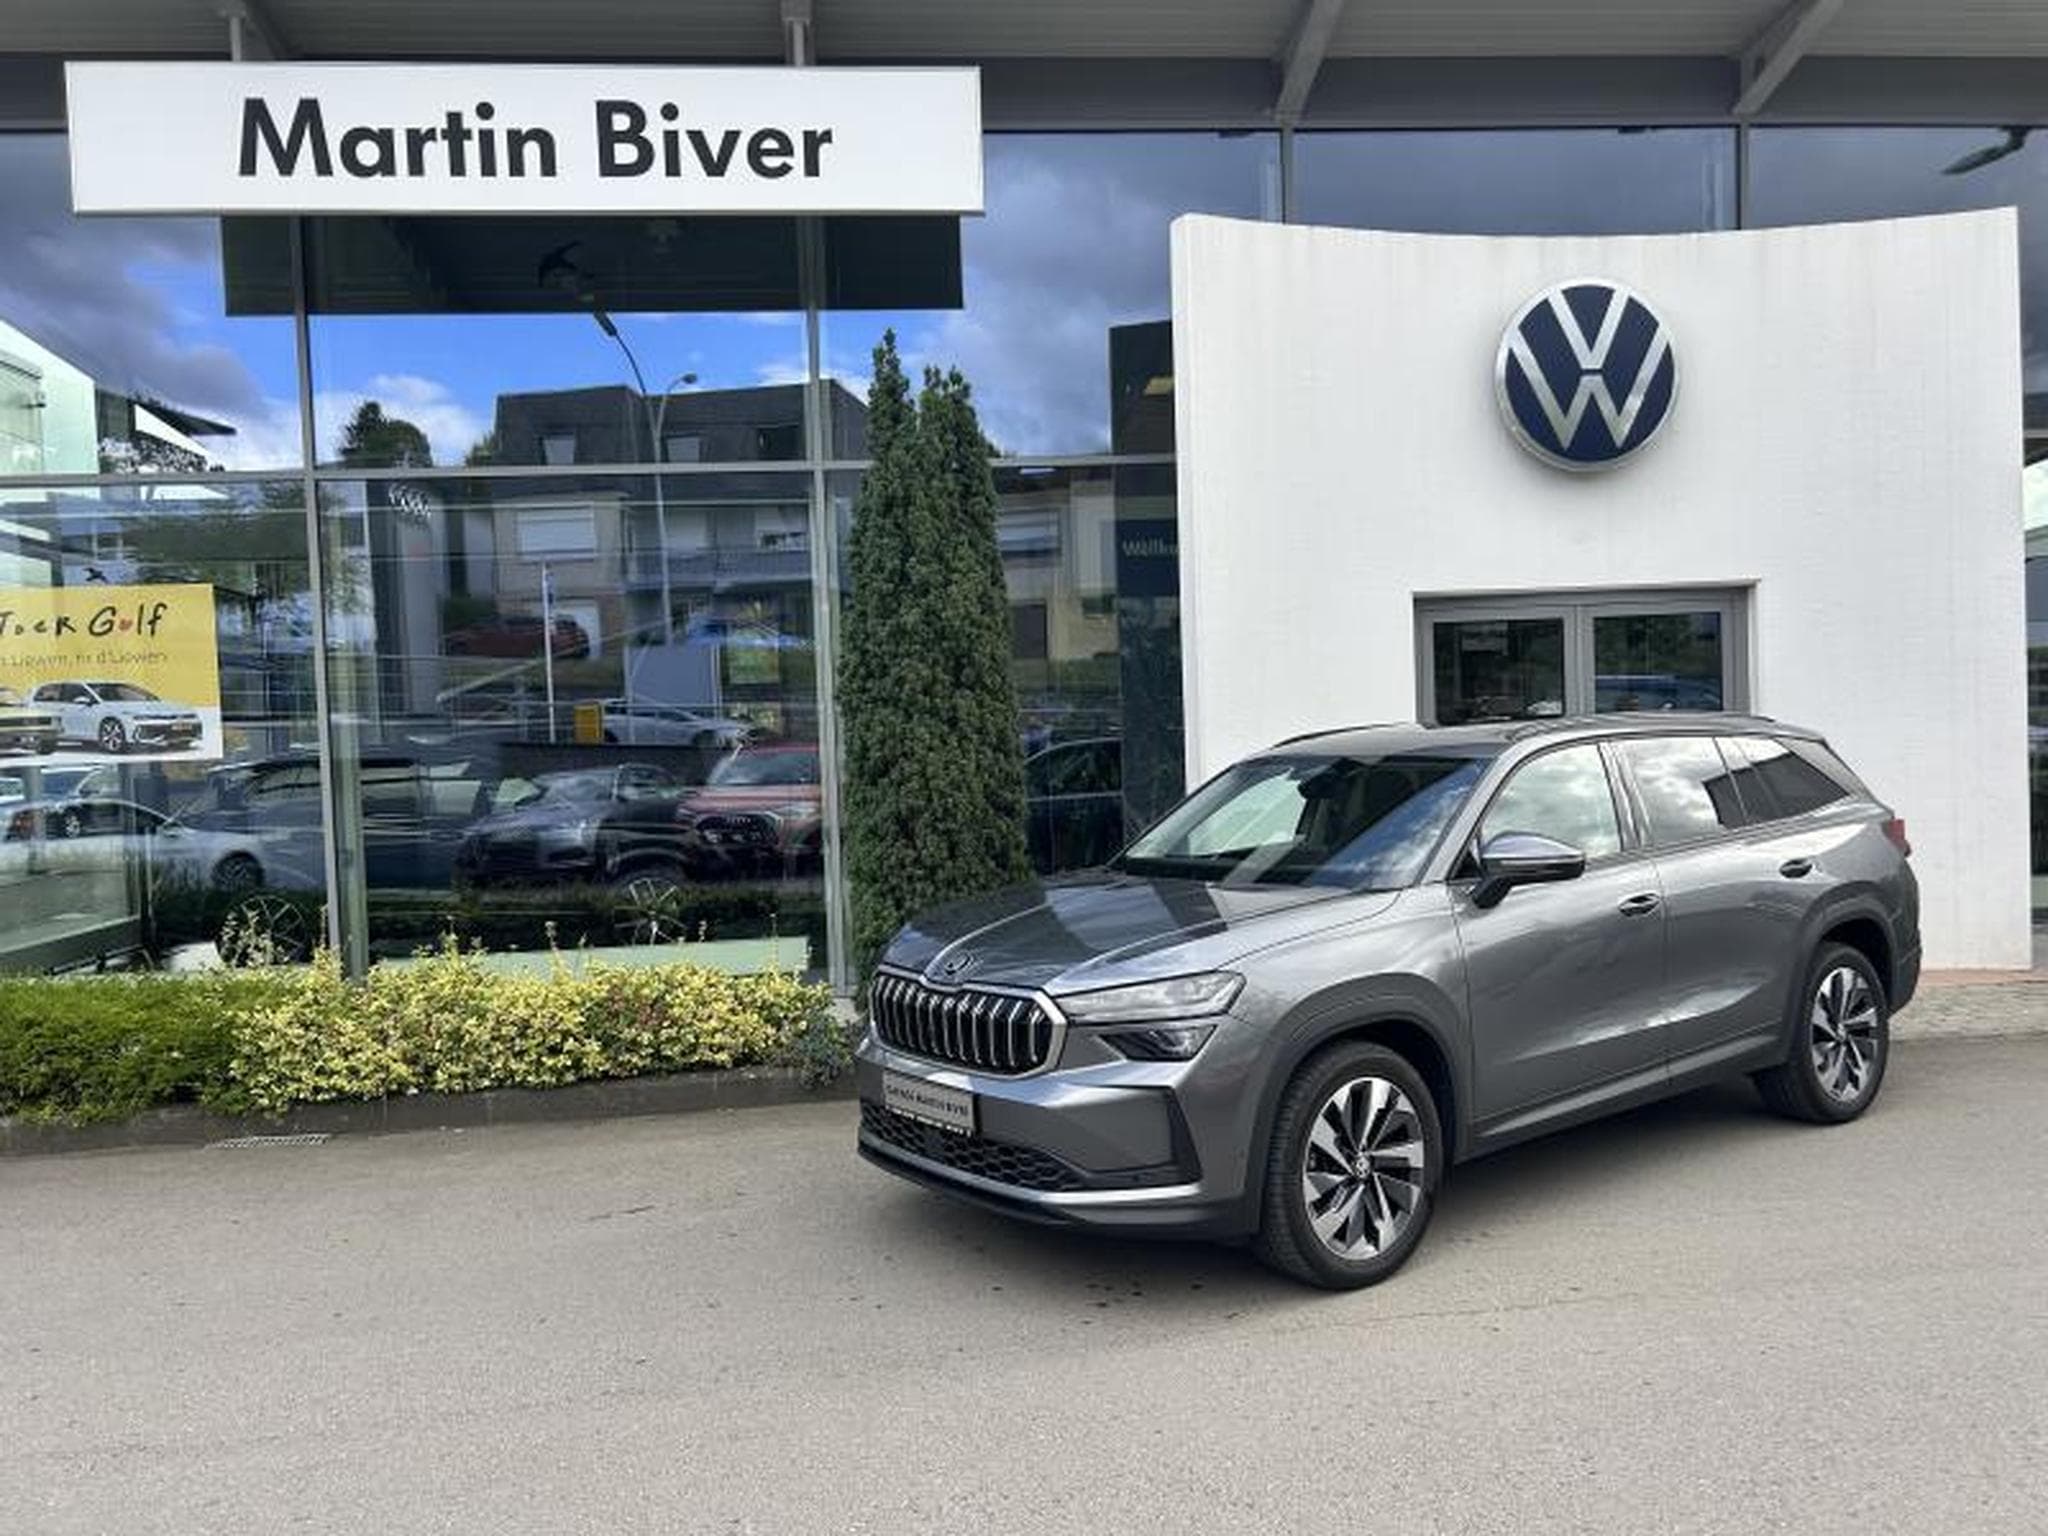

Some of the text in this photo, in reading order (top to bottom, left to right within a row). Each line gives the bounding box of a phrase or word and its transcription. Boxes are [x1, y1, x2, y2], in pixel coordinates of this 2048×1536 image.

[238, 98, 833, 179] Martin Biver
[1504, 283, 1672, 456] VW
[88, 602, 168, 637] Golf
